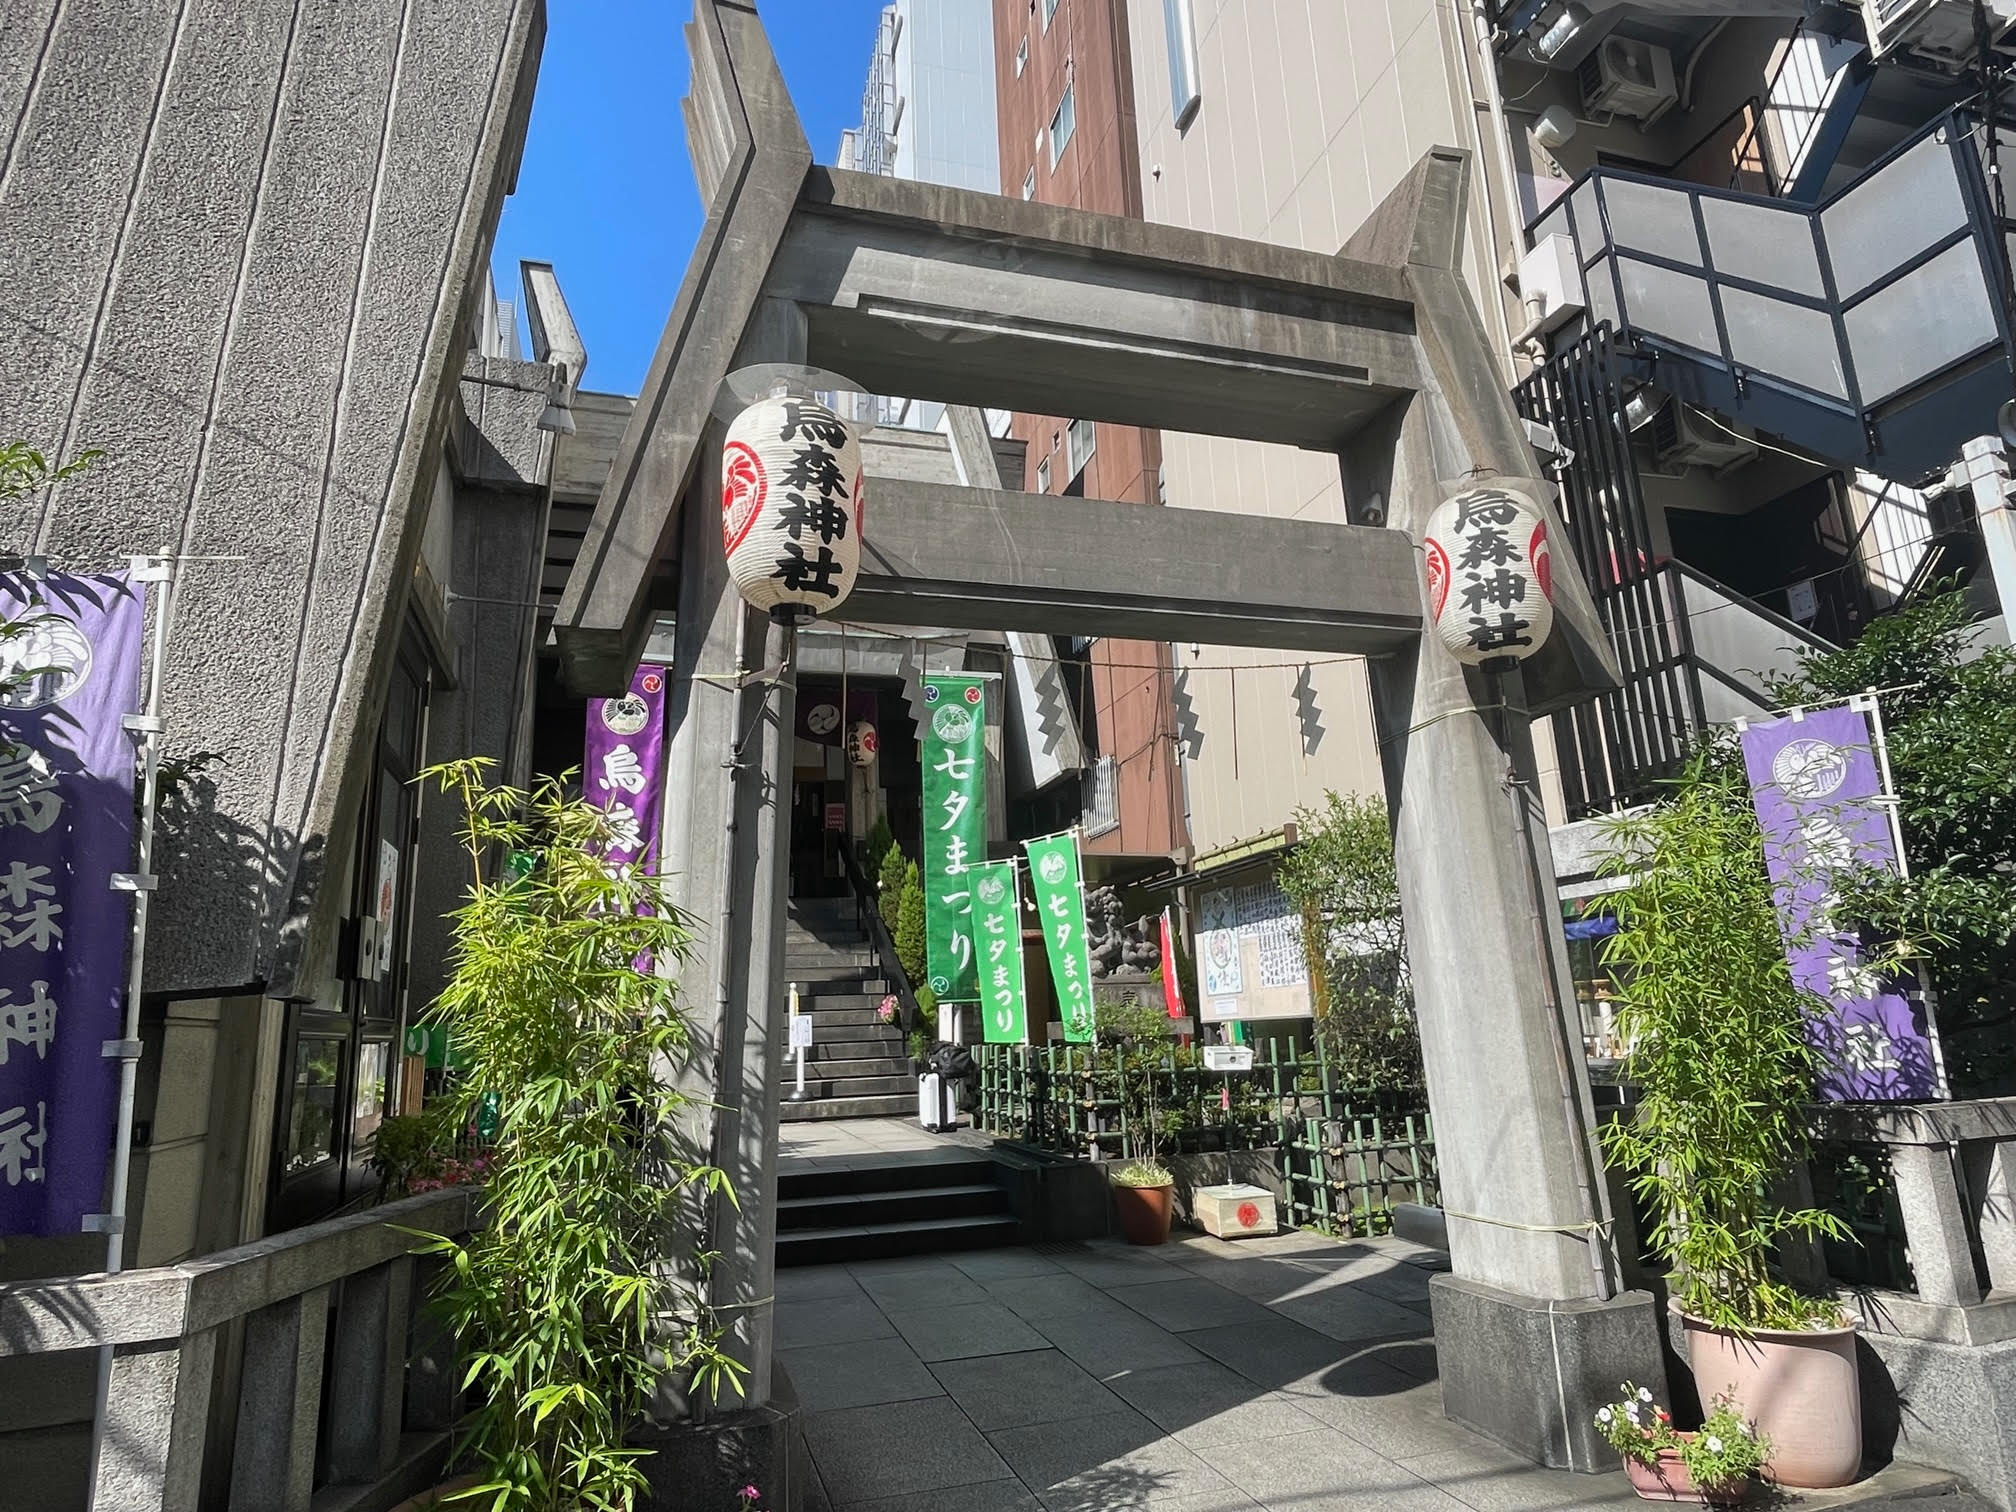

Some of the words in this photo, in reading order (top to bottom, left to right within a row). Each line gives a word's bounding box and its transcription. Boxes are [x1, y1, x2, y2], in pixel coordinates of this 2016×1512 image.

[770, 401, 849, 599] 烏森神社
[1453, 489, 1533, 651] 烏森神社
[597, 743, 647, 965] 烏森
[933, 747, 977, 970] 七夕まつり
[983, 912, 1014, 1034] 七夕まつり
